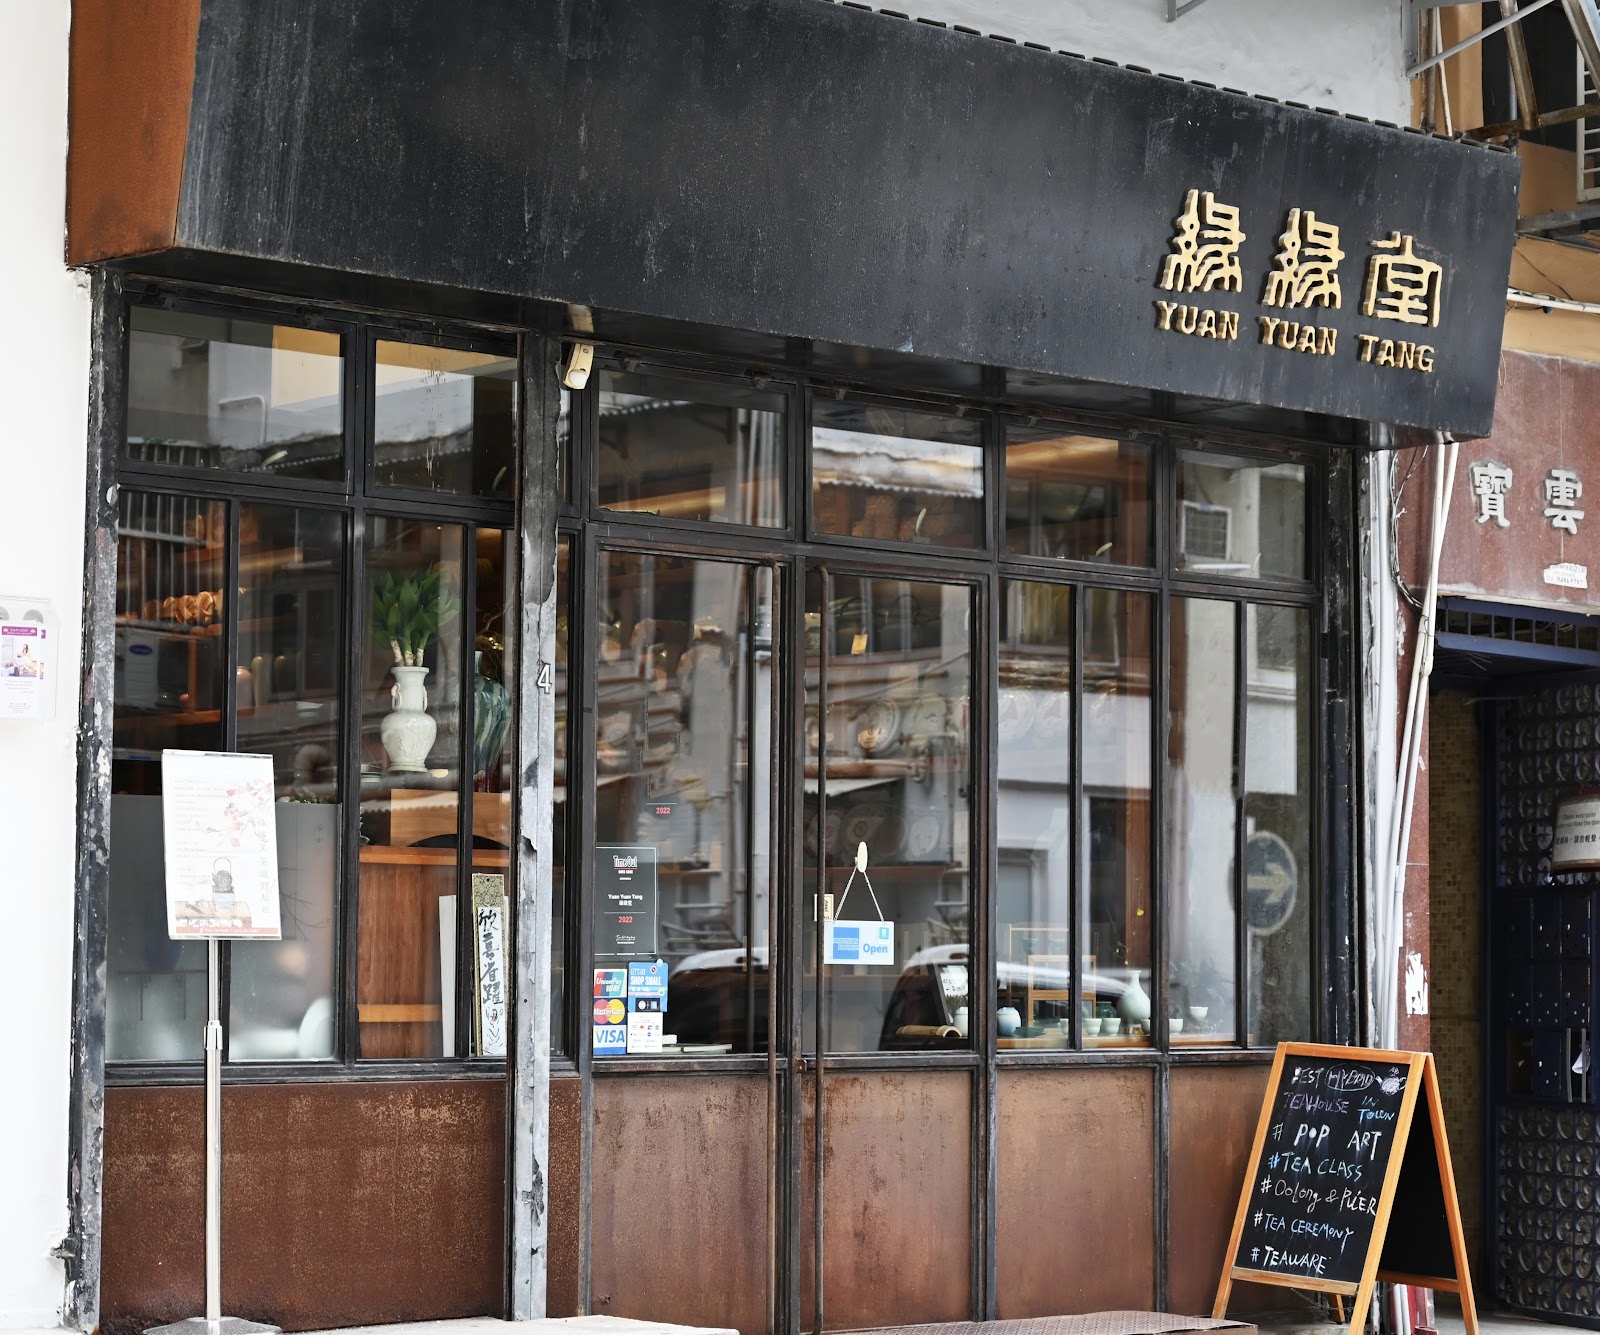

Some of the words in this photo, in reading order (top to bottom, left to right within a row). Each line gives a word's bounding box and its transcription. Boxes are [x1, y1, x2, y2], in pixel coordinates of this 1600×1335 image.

[1156, 300, 1240, 341] YUAN
[1258, 316, 1338, 356] YUAN
[1358, 333, 1436, 372] TANG
[536, 660, 553, 694] 4
[862, 943, 888, 955] Open
[631, 976, 645, 985] SHOP
[645, 976, 661, 985] SMALL
[595, 1030, 625, 1043] VISA
[1291, 1066, 1325, 1089] BEST
[1283, 1091, 1350, 1115] TEAHOUSE
[1346, 1130, 1383, 1161] ART
[1317, 1158, 1363, 1182] CLASS
[1325, 1189, 1340, 1203] &
[1291, 1218, 1355, 1256] CEREMONY
